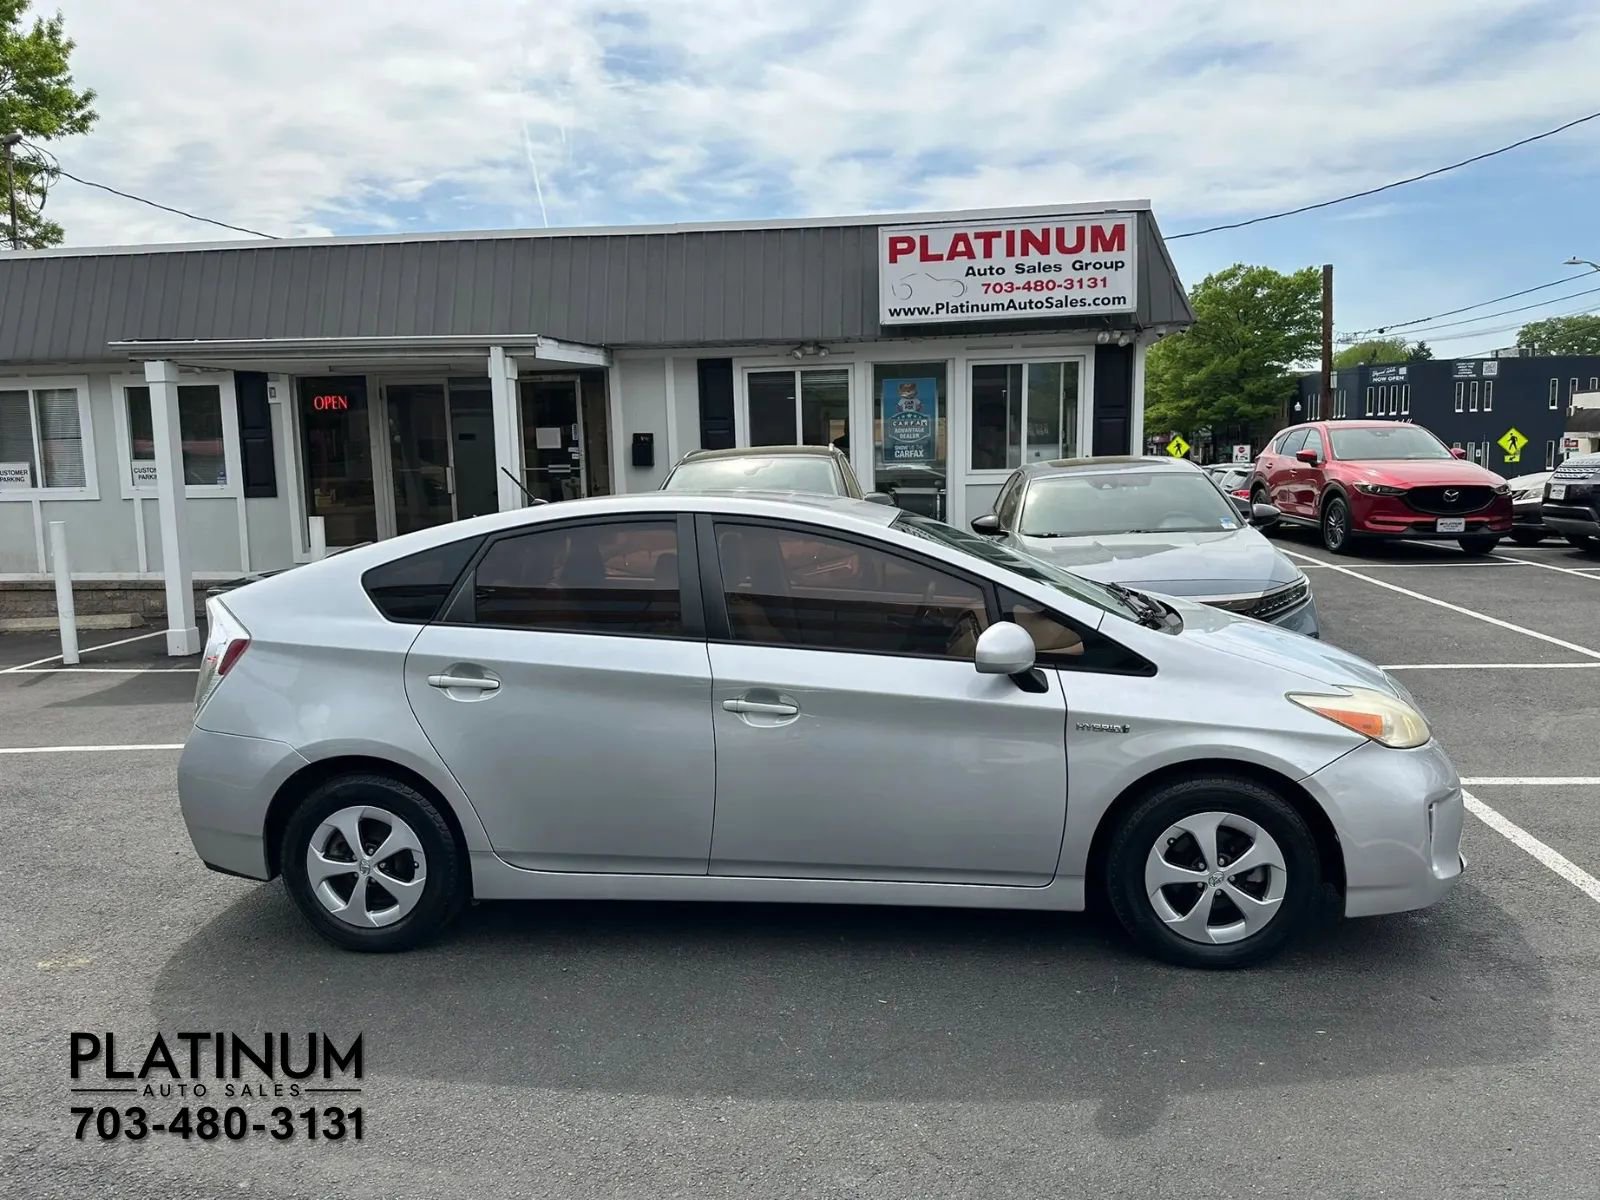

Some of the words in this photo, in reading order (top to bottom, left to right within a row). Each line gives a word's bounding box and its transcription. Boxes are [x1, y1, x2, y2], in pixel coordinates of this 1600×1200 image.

[888, 223, 1126, 264] PLATINUM
[965, 265, 1006, 277] Auto
[1014, 262, 1062, 275] Sales
[1071, 259, 1125, 273] Group
[981, 276, 1108, 295] 703-480-3131
[888, 295, 1127, 317] www.PlatinumAutoSales.com
[313, 395, 348, 410] OPEN
[894, 450, 924, 458] CARFAX
